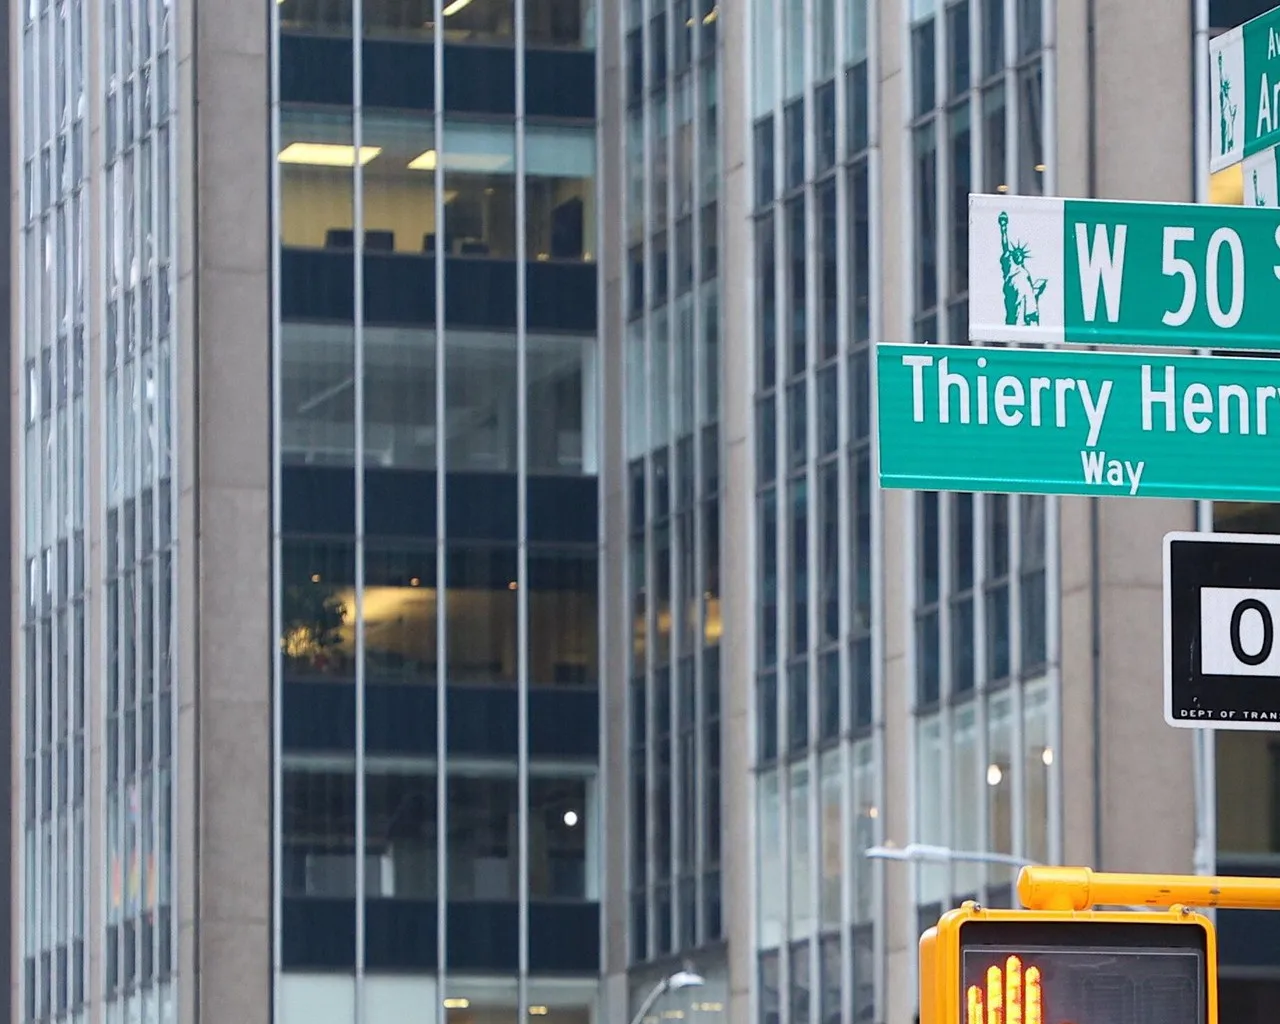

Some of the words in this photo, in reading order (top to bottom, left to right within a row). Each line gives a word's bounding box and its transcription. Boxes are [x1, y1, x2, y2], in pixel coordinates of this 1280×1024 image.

[1074, 222, 1127, 323] W
[1161, 226, 1245, 328] 50
[902, 355, 1113, 447] Thierry
[1081, 450, 1145, 496] Way
[1180, 709, 1213, 718] DEPT
[1220, 710, 1236, 718] OF
